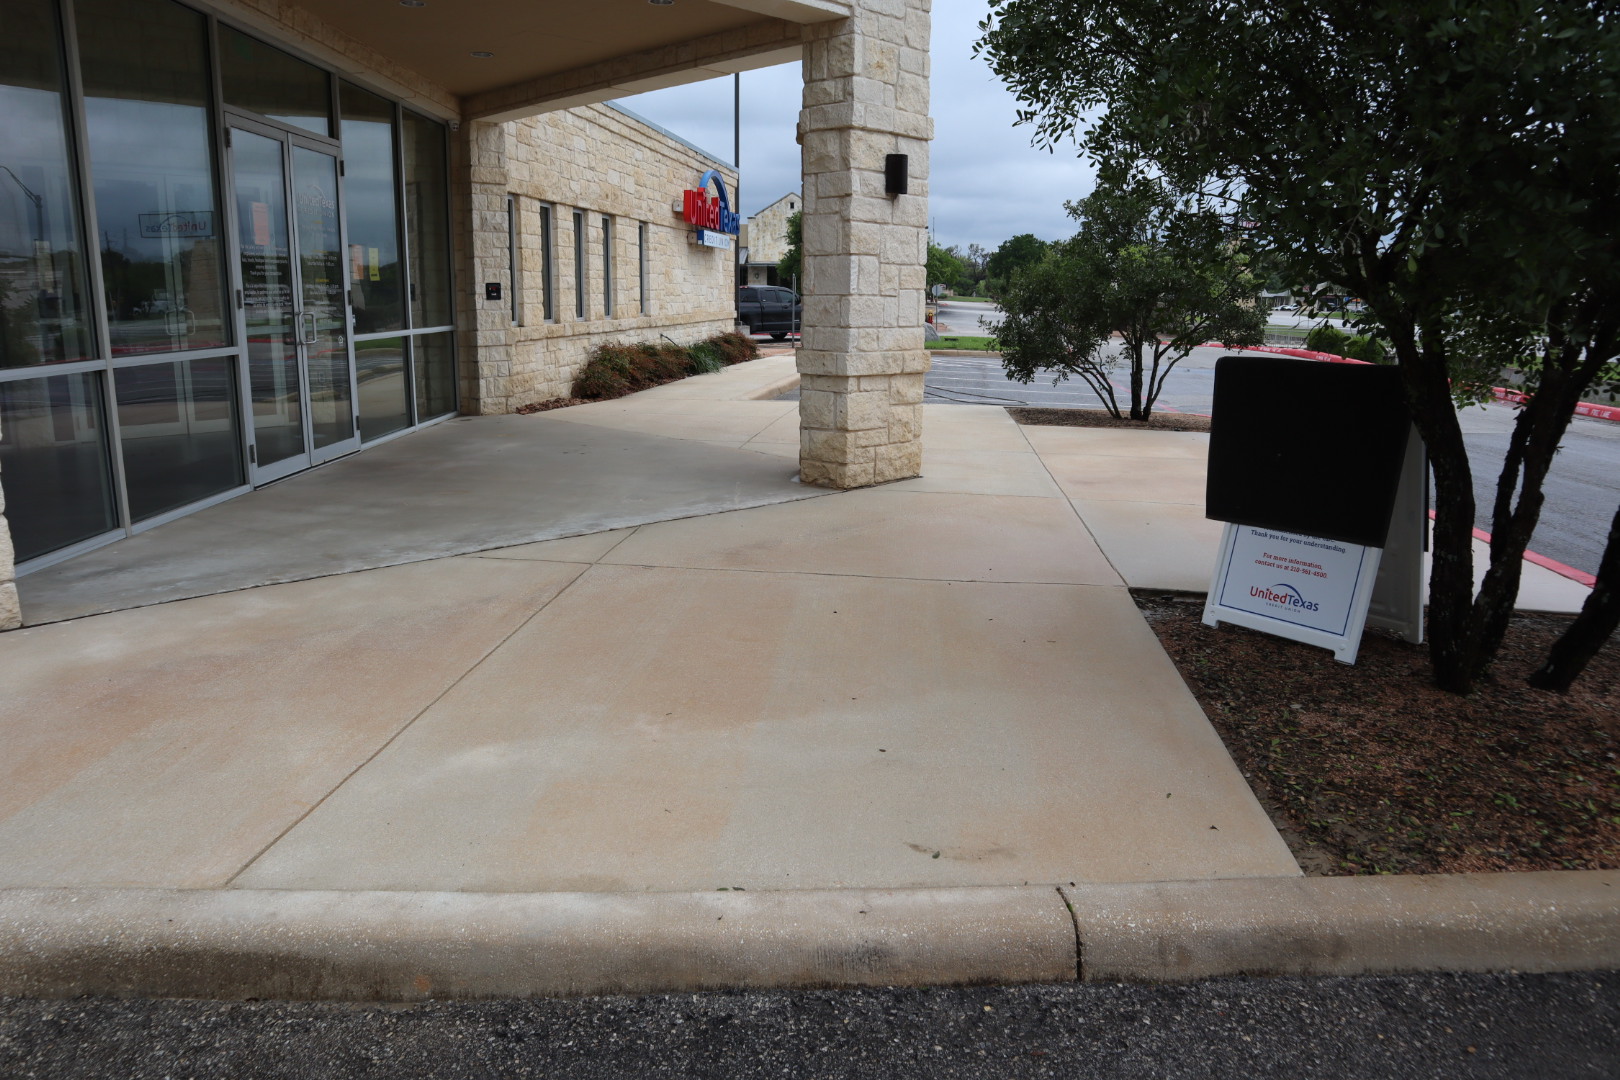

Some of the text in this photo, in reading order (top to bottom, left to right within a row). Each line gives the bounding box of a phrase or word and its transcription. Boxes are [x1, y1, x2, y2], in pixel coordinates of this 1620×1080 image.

[1251, 529, 1268, 538] Thank
[1269, 533, 1279, 541] you
[1289, 537, 1303, 545] your
[1254, 559, 1275, 567] contact
[1263, 552, 1272, 560] For
[1273, 555, 1287, 563] more
[1250, 586, 1319, 611] UnitedTexas
